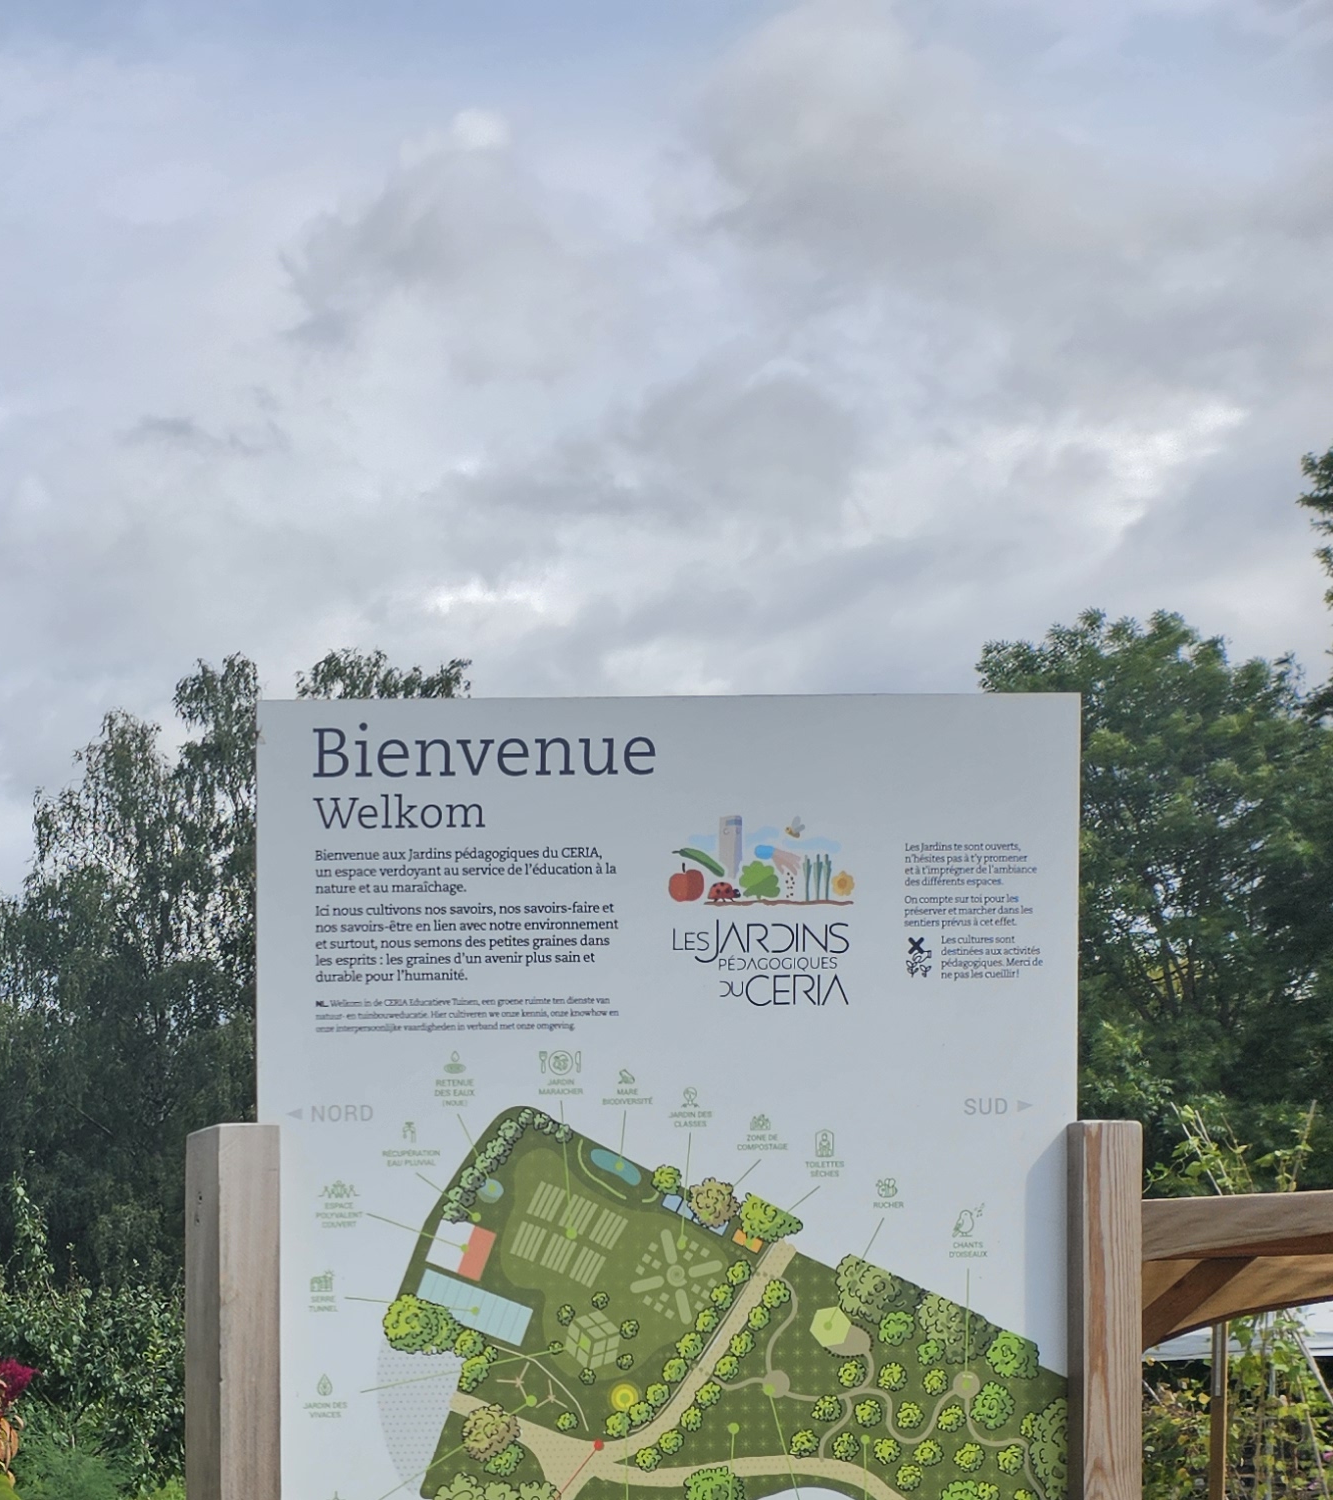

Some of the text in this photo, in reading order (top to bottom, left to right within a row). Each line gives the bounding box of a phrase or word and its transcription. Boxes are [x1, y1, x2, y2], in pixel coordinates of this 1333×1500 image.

[312, 722, 657, 779] Bienvenue
[313, 794, 486, 829] Welkom
[315, 846, 602, 862] Bienvenue aux Jardins pédagogiques du CERIA,
[905, 843, 919, 851] Les
[921, 842, 952, 852] Jardins
[985, 843, 1021, 851] ouverts,
[905, 854, 1027, 864] n'hésites pas à t'y promener
[315, 862, 616, 880] un espace verdoyant au service de l'éducation à la
[915, 866, 921, 874] à
[922, 865, 973, 878] t'imprégner
[976, 865, 987, 874] de
[989, 865, 1037, 874] l'ambiance
[315, 881, 466, 896] nature et au maraîchage.
[315, 902, 614, 916] Ici nous cultivons nos savoirs, nos savoirs-faire et
[315, 919, 619, 932] nos savoirs-être en lien avec notre environnement
[672, 919, 850, 963] LES JARDINS
[718, 956, 838, 971] PÉDAGOGIQUES
[719, 974, 849, 1006] DU CERIA
[435, 1079, 474, 1087] RETENUE
[602, 1097, 653, 1105] BIODIVERSITÉ
[964, 1098, 1008, 1115] SUD
[311, 1105, 374, 1122] NORD
[674, 1120, 707, 1128] CLASSES
[382, 1149, 440, 1157] RÉCUPÉRATION
[737, 1143, 788, 1151] COMPOSTAGE
[810, 1169, 839, 1177] SÈCHES
